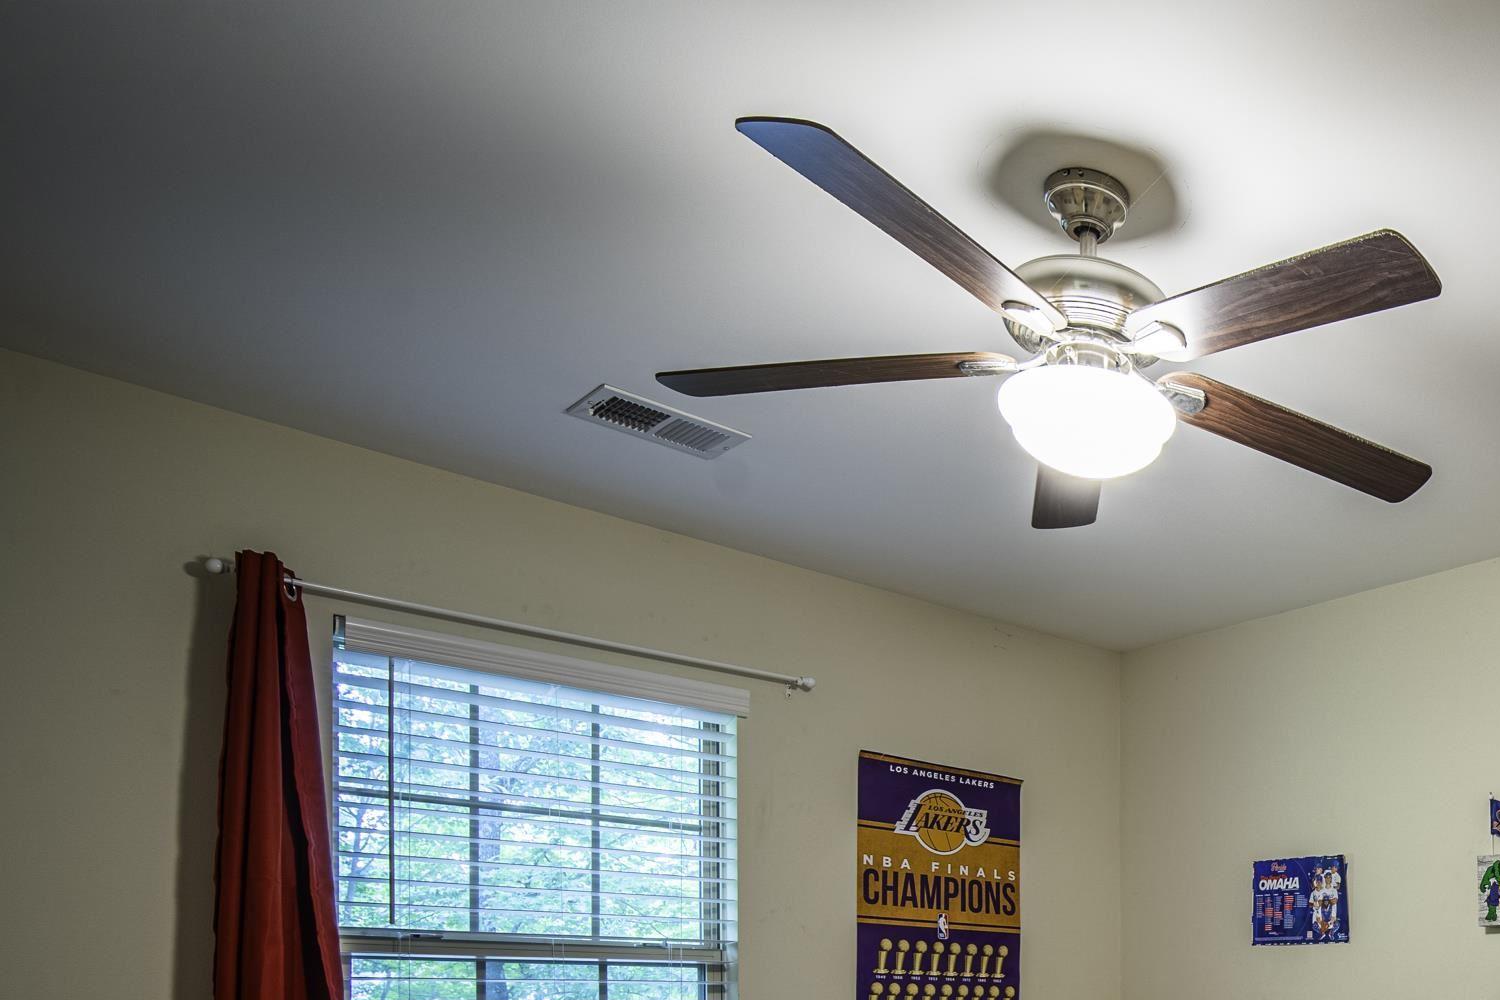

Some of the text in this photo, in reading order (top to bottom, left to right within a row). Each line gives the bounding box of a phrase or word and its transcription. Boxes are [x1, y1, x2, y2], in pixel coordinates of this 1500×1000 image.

[889, 764, 995, 789] LOS ANGELES LAKERS
[904, 802, 987, 842] LAKERS
[944, 808, 984, 818] ANGELES
[863, 854, 1016, 881] NBA FINALS
[862, 868, 1016, 916] CHAMPIONS
[1258, 877, 1300, 891] OMAHA
